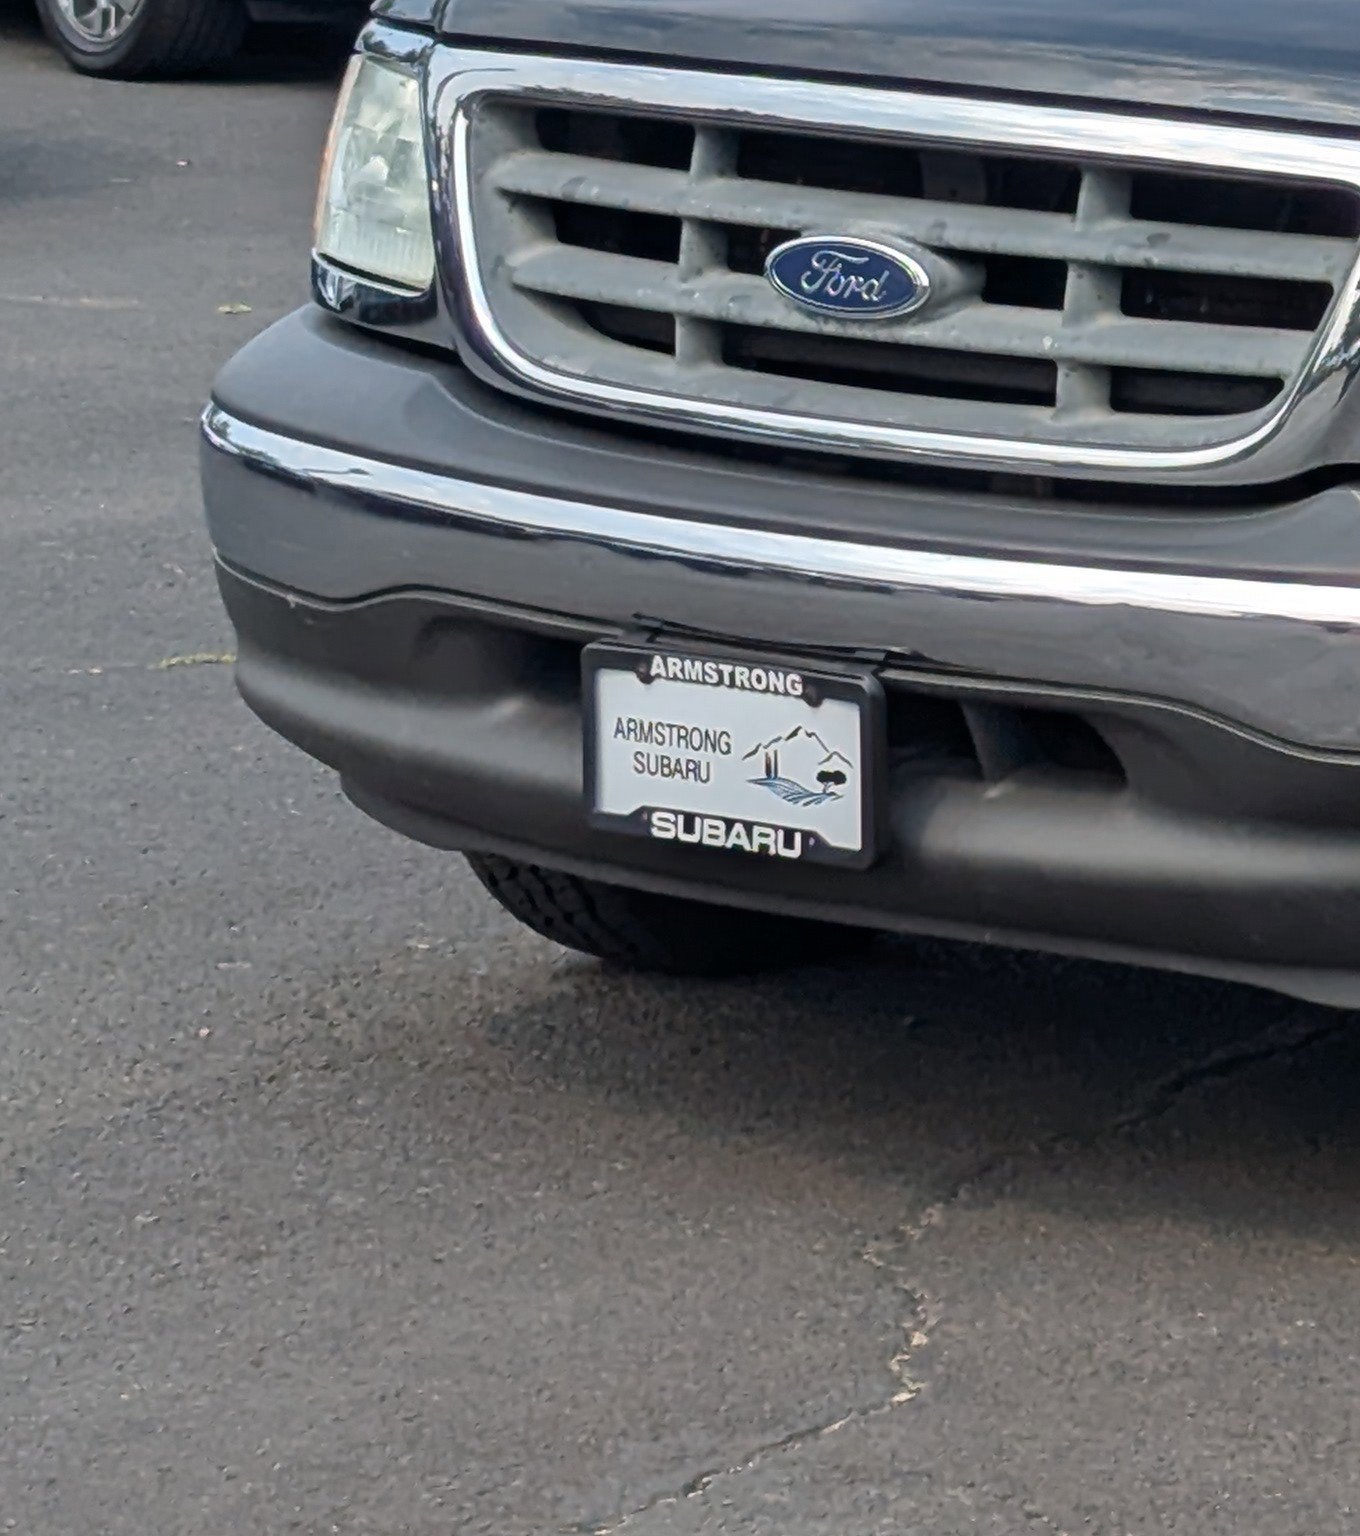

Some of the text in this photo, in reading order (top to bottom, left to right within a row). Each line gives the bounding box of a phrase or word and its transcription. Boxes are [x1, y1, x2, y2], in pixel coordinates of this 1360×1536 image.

[801, 250, 889, 302] Ford
[650, 654, 803, 696] ARMSTRONG
[612, 716, 733, 756] ARMSTRONG
[632, 750, 712, 784] SUBARU
[650, 810, 803, 859] SUBARU
